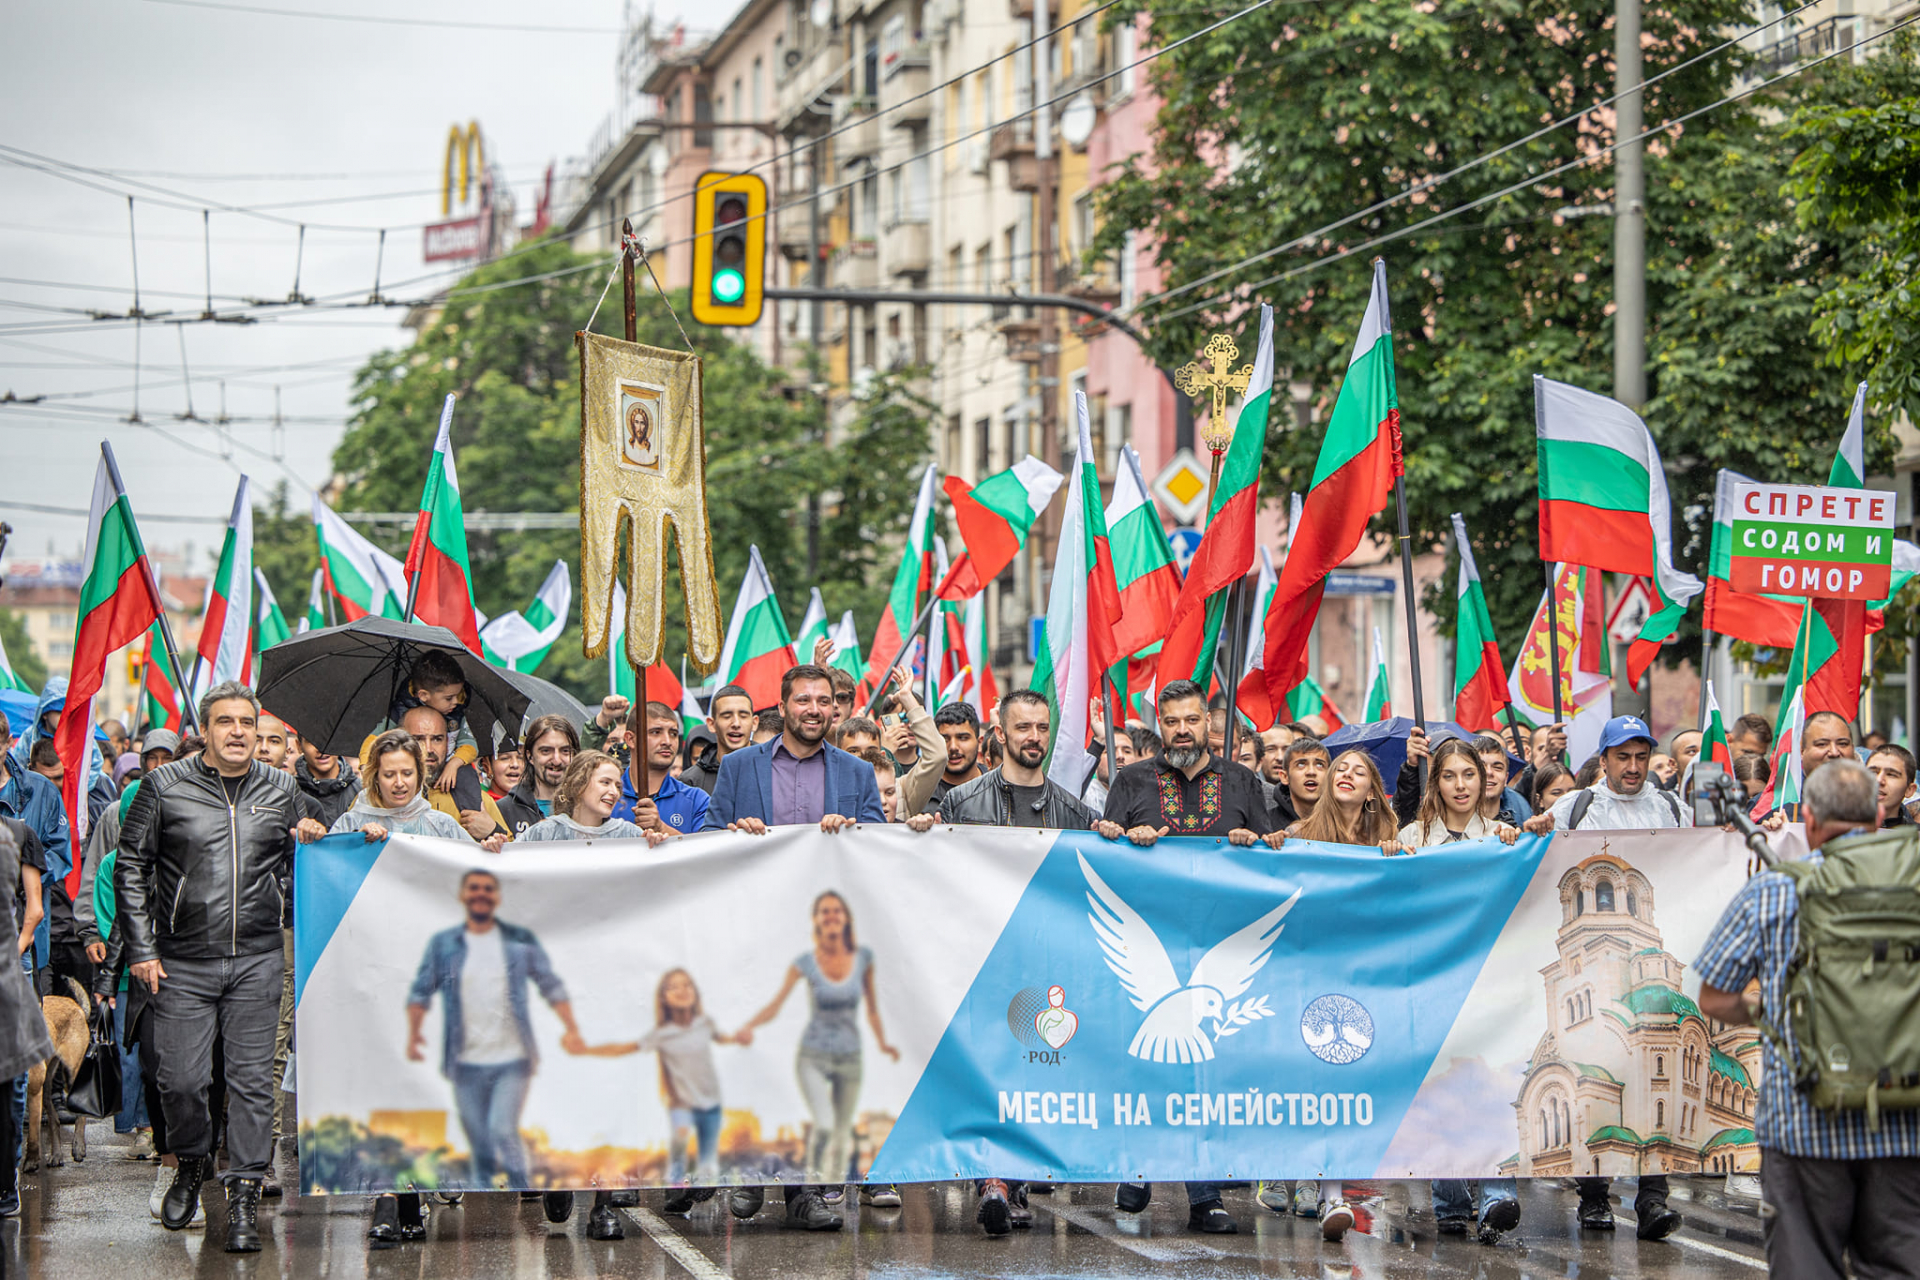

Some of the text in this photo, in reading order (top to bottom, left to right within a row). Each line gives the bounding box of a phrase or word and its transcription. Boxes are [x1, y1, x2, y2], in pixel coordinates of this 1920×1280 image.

[1744, 491, 1885, 521] СПРЕТЕ
[1743, 528, 1881, 555] СОДОМ И
[1761, 564, 1863, 593] ГОМОР
[998, 1087, 1373, 1129] МЕСЕЦ НА СЕМЕЙСТВОТО
